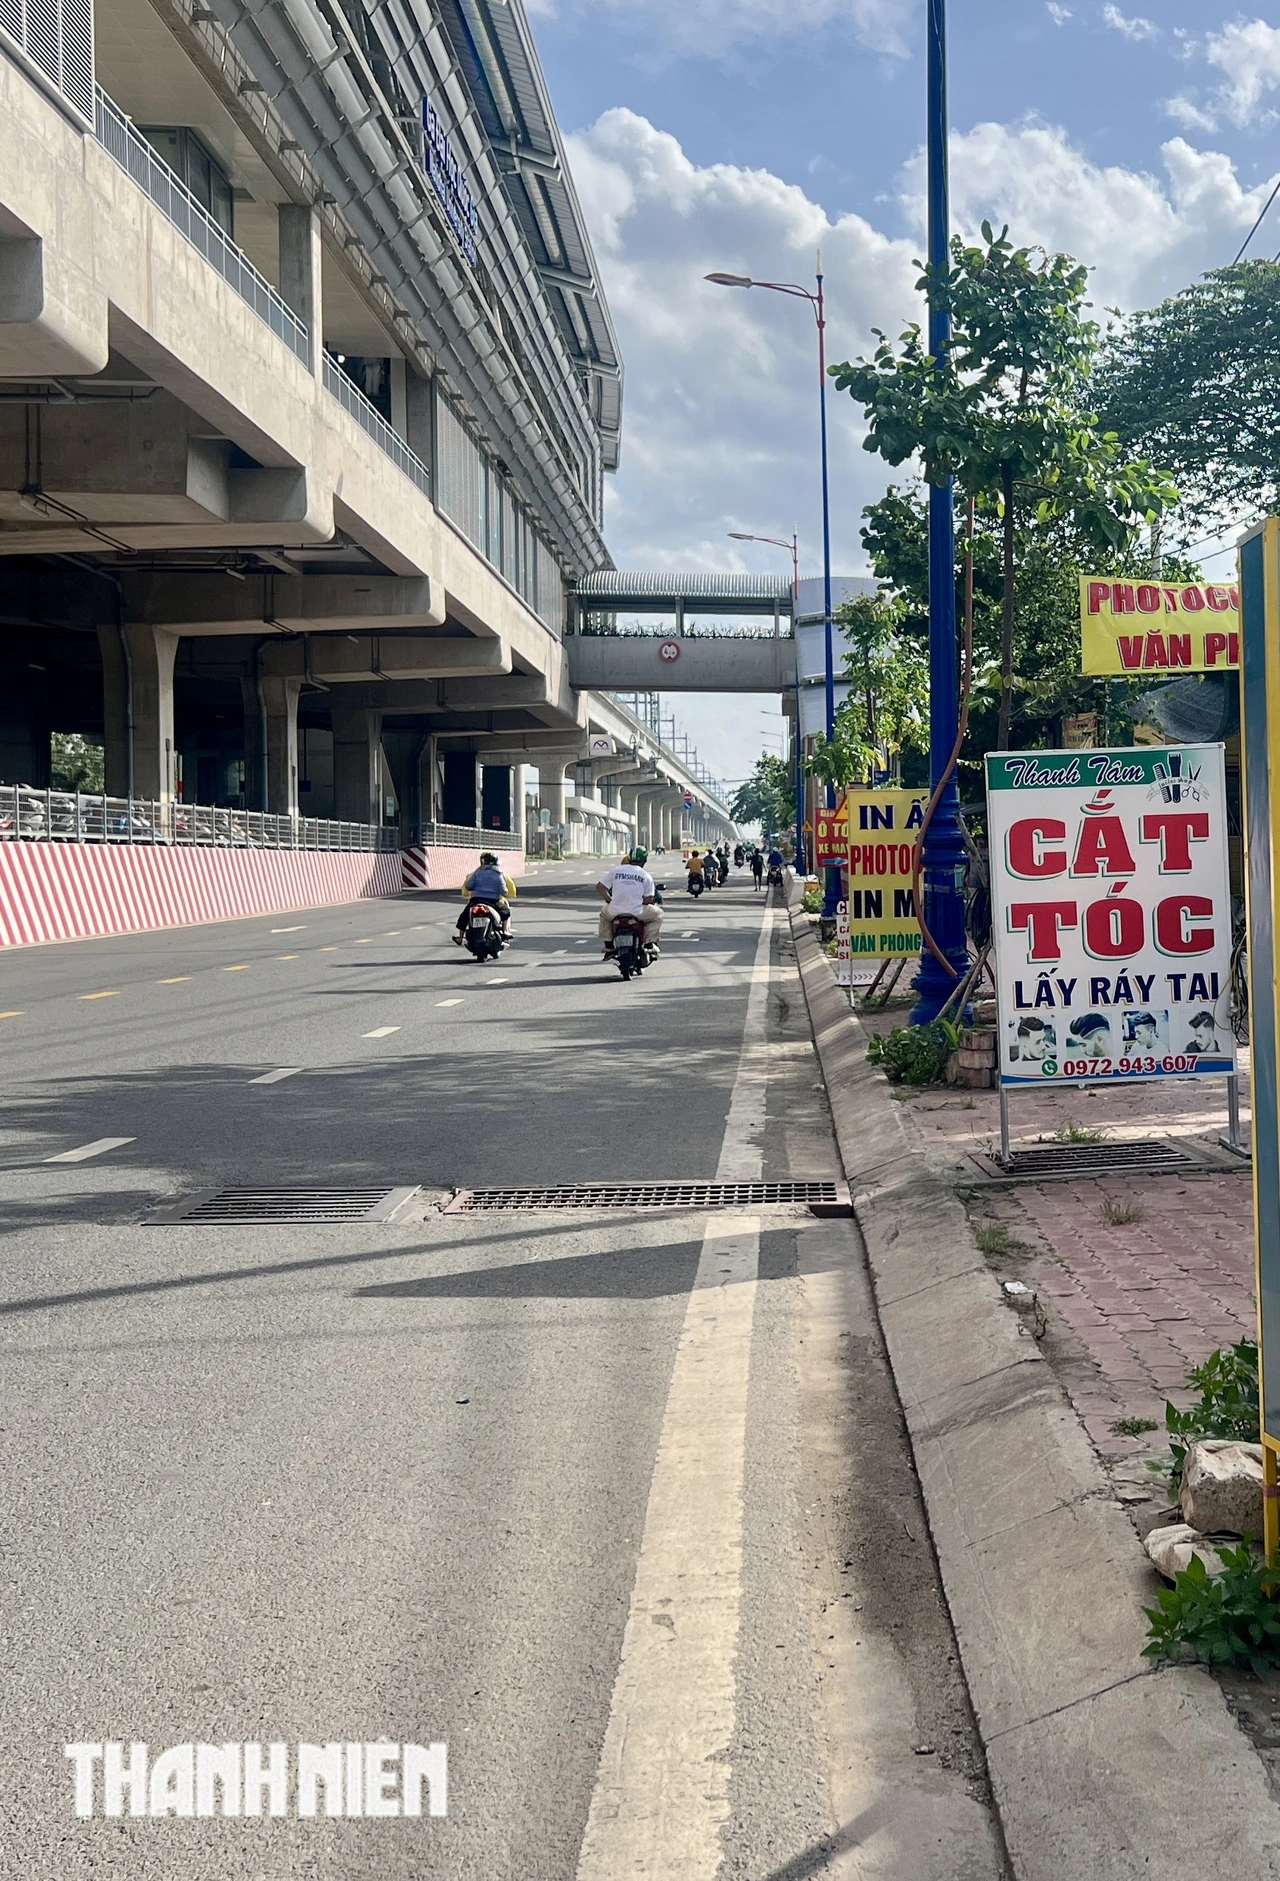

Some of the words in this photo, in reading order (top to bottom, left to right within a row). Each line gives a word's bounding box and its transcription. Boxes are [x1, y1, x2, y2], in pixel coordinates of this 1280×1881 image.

[1117, 629, 1192, 670] VĂN
[1005, 758, 1080, 787] Thanh
[1088, 755, 1145, 784] Tâm
[859, 804, 894, 830] IN
[903, 795, 929, 830] Ấ
[1004, 788, 1210, 881] CẮT
[854, 889, 883, 918] IN
[1006, 880, 1216, 964] TÓC
[851, 932, 876, 953] VĂN
[880, 930, 922, 953] PHÒNG
[1013, 967, 1078, 1011] LẤY
[1089, 967, 1156, 1008] RÁY
[1166, 972, 1219, 1004] TAI
[1062, 1058, 1113, 1077] 0972
[1118, 1055, 1156, 1074] 943
[1162, 1054, 1199, 1072] 607
